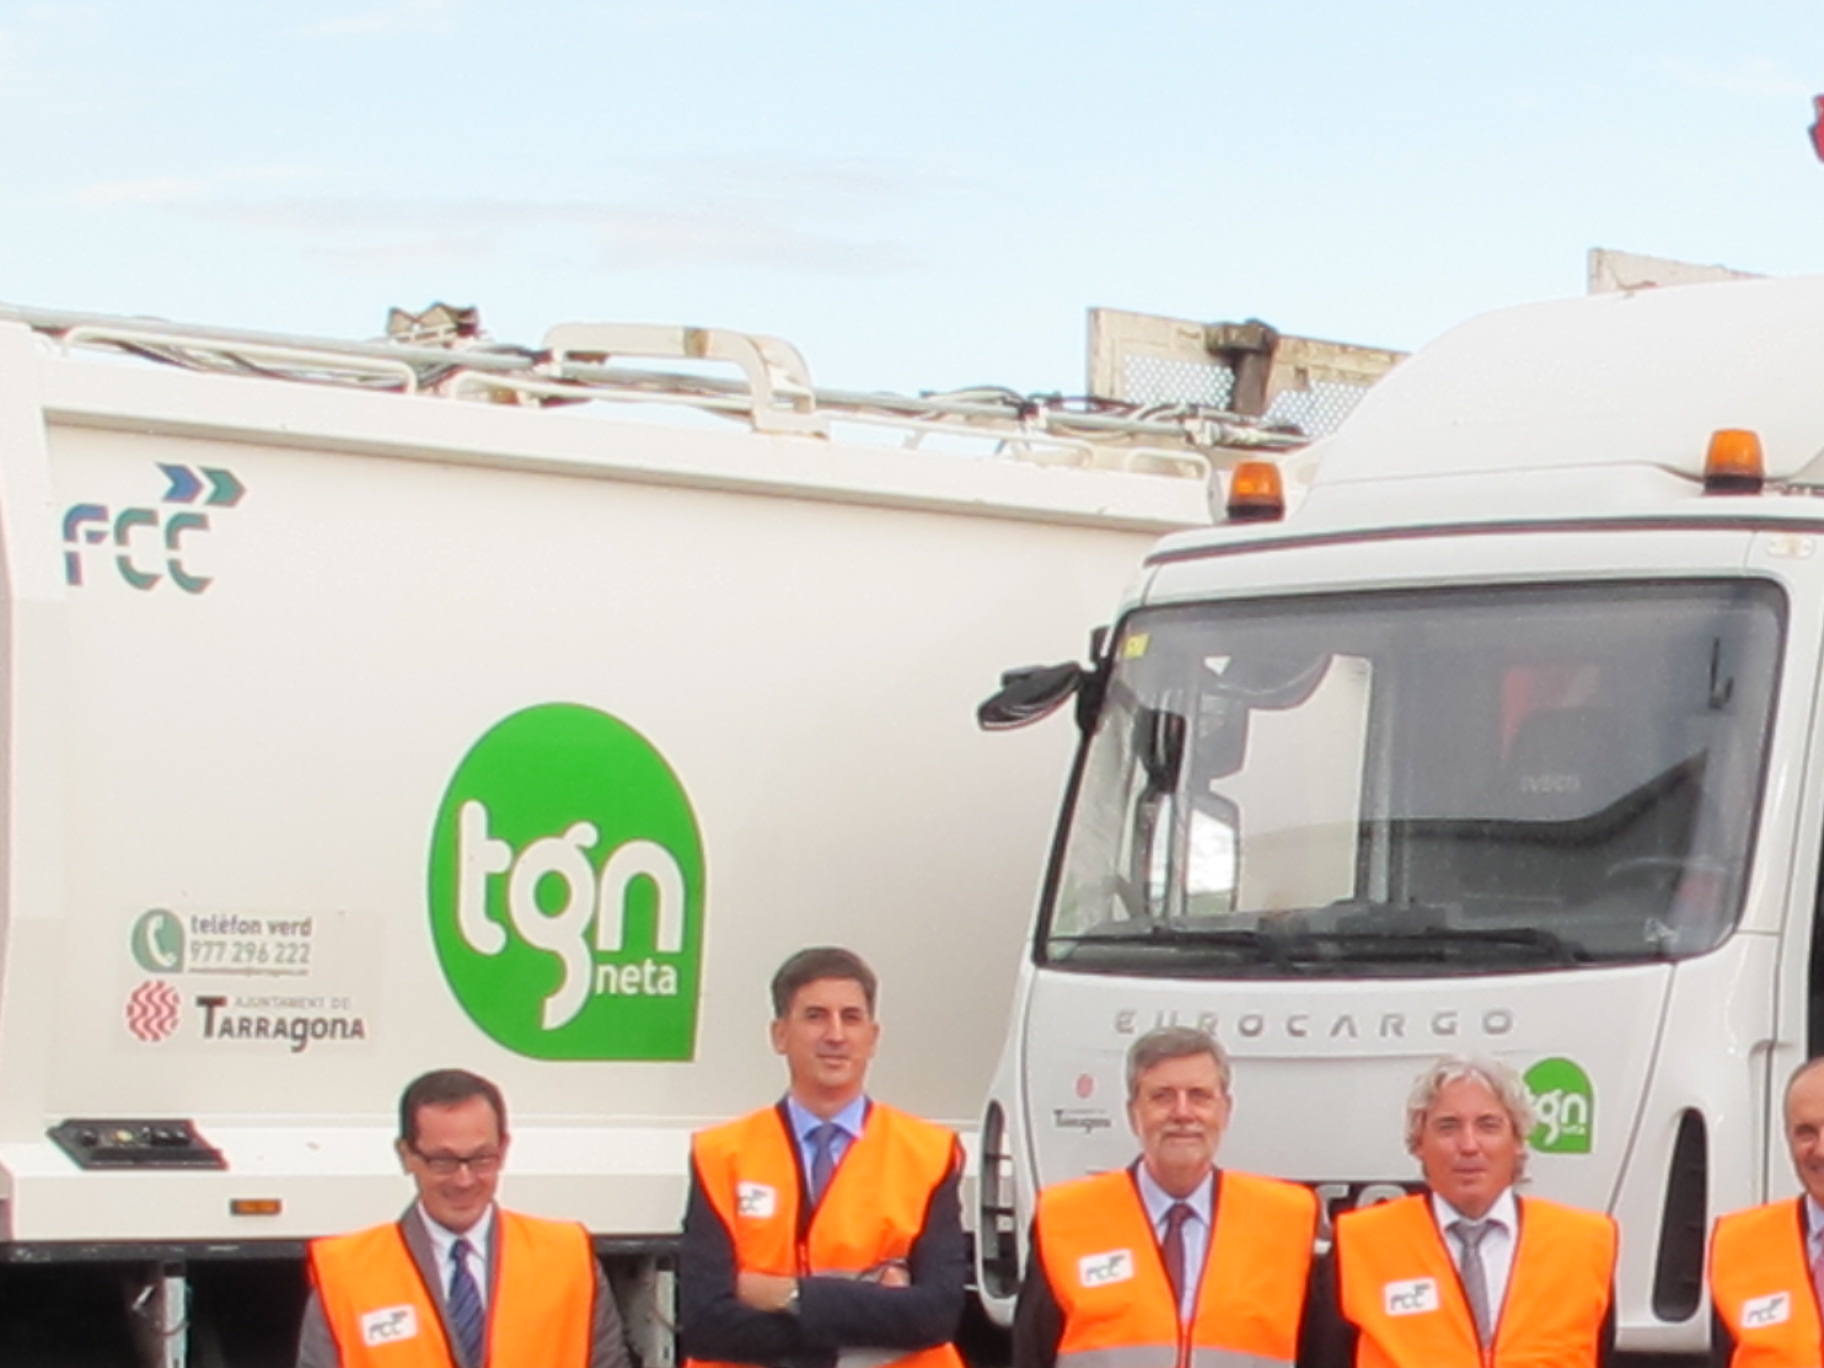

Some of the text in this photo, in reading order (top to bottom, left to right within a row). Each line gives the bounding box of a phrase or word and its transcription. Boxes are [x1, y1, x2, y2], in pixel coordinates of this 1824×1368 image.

[62, 504, 213, 594] FCC
[267, 917, 312, 936] verd
[457, 799, 685, 1030] tgn
[191, 940, 310, 965] 977 296 222
[596, 957, 678, 996] neta
[1114, 1008, 1513, 1037] EUROCARGO
